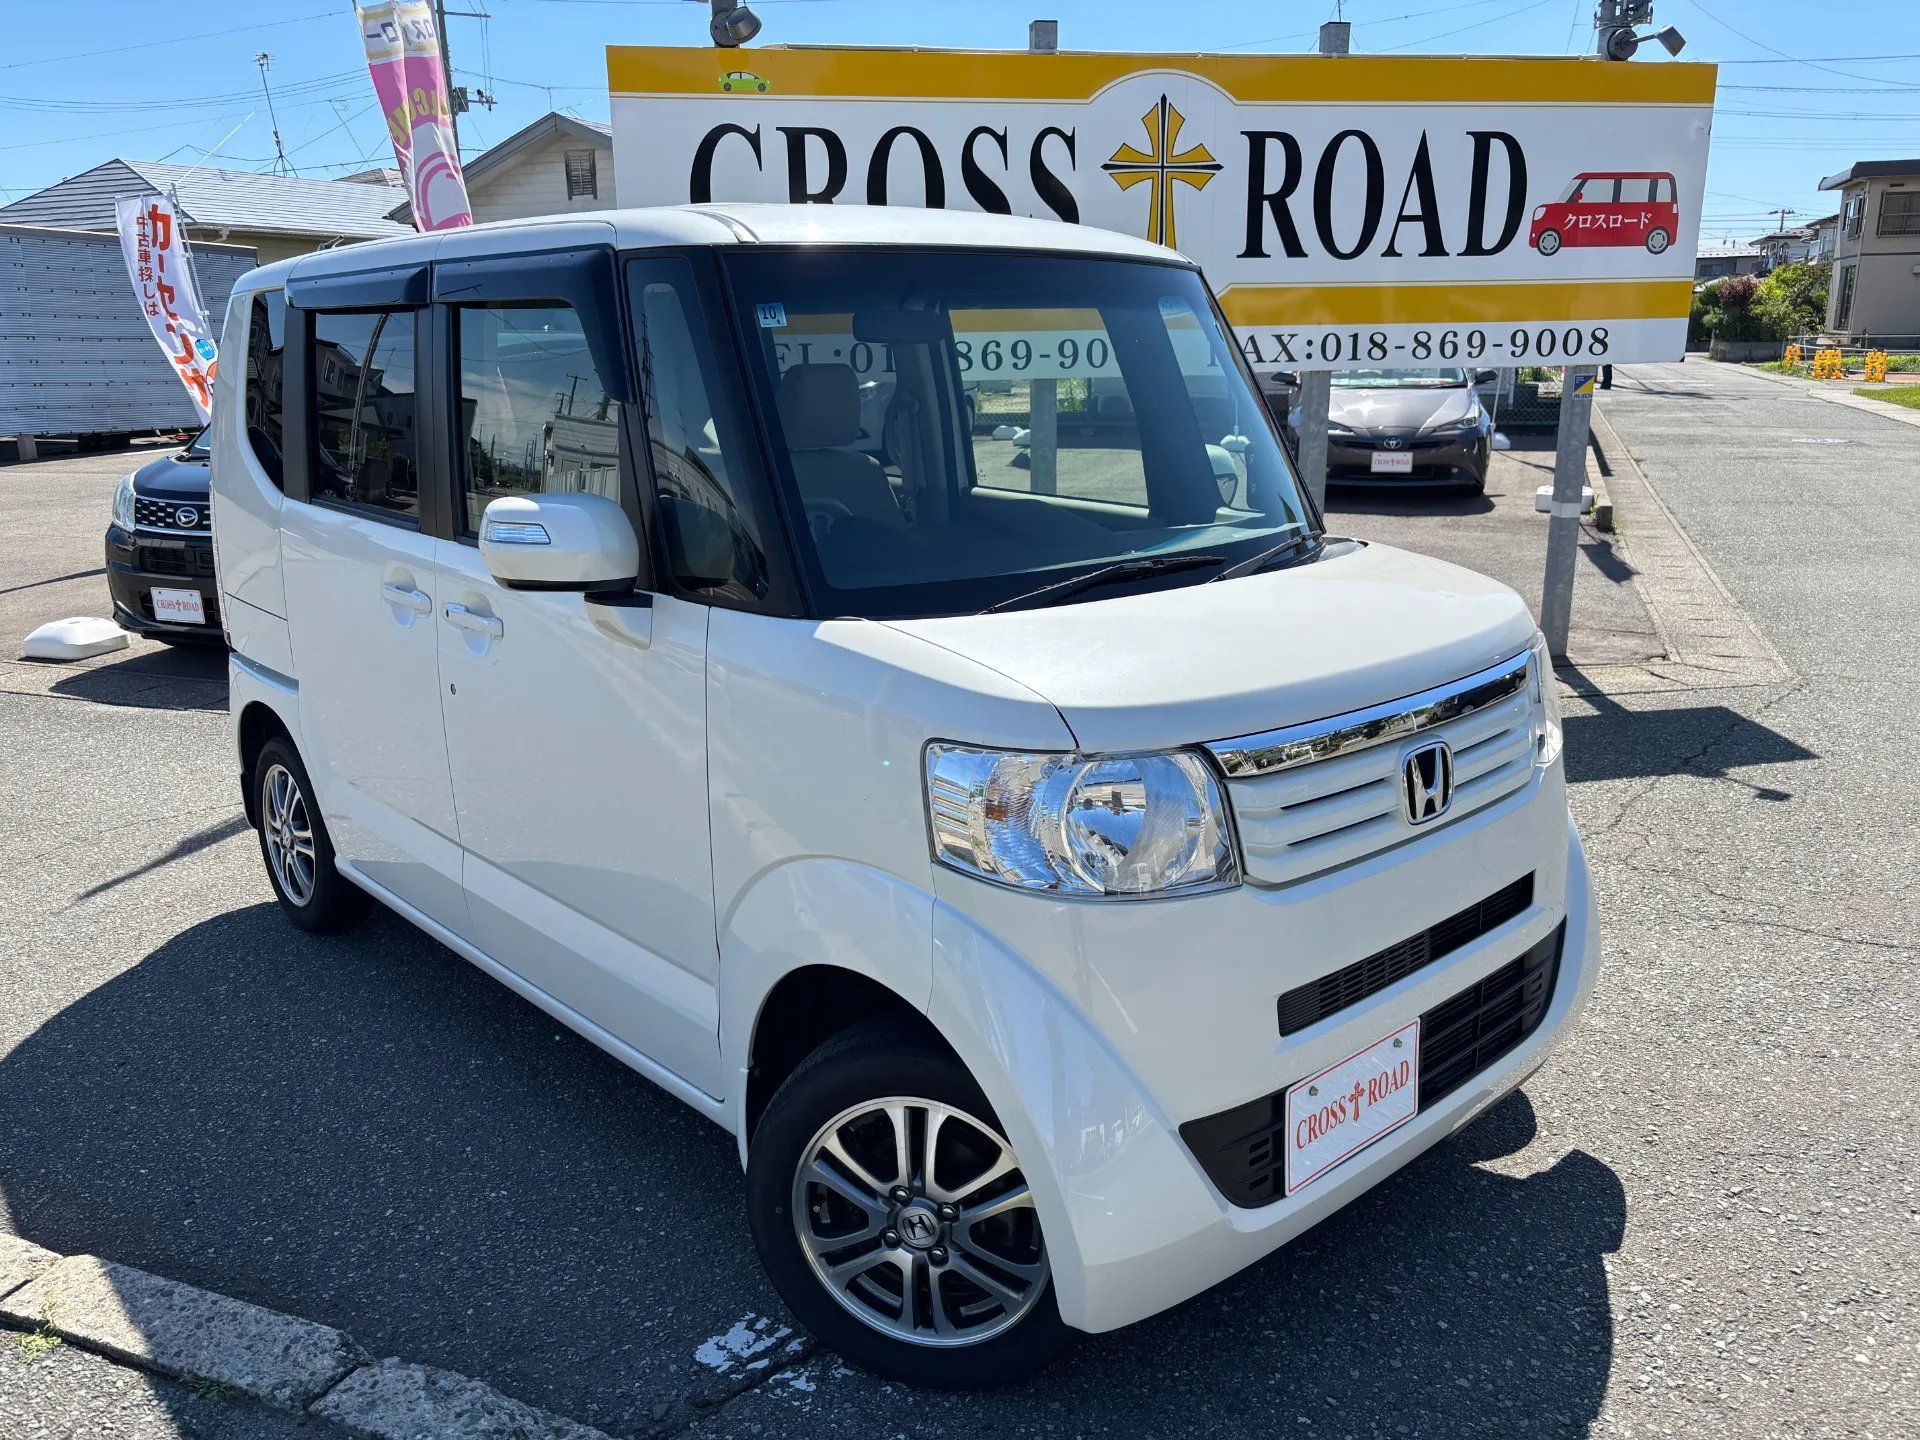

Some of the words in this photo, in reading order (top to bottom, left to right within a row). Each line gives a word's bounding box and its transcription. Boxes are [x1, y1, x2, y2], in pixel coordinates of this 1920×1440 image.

[690, 123, 1080, 224] CROSS
[1236, 128, 1528, 260] ROAD
[1563, 211, 1652, 231] クロスロード
[136, 214, 160, 317] 中古車探しは
[761, 305, 777, 320] 10
[156, 599, 176, 610] CROSS
[181, 600, 200, 612] ROAD
[1296, 1095, 1347, 1150] CROSS
[1367, 1060, 1410, 1107] ROAD
